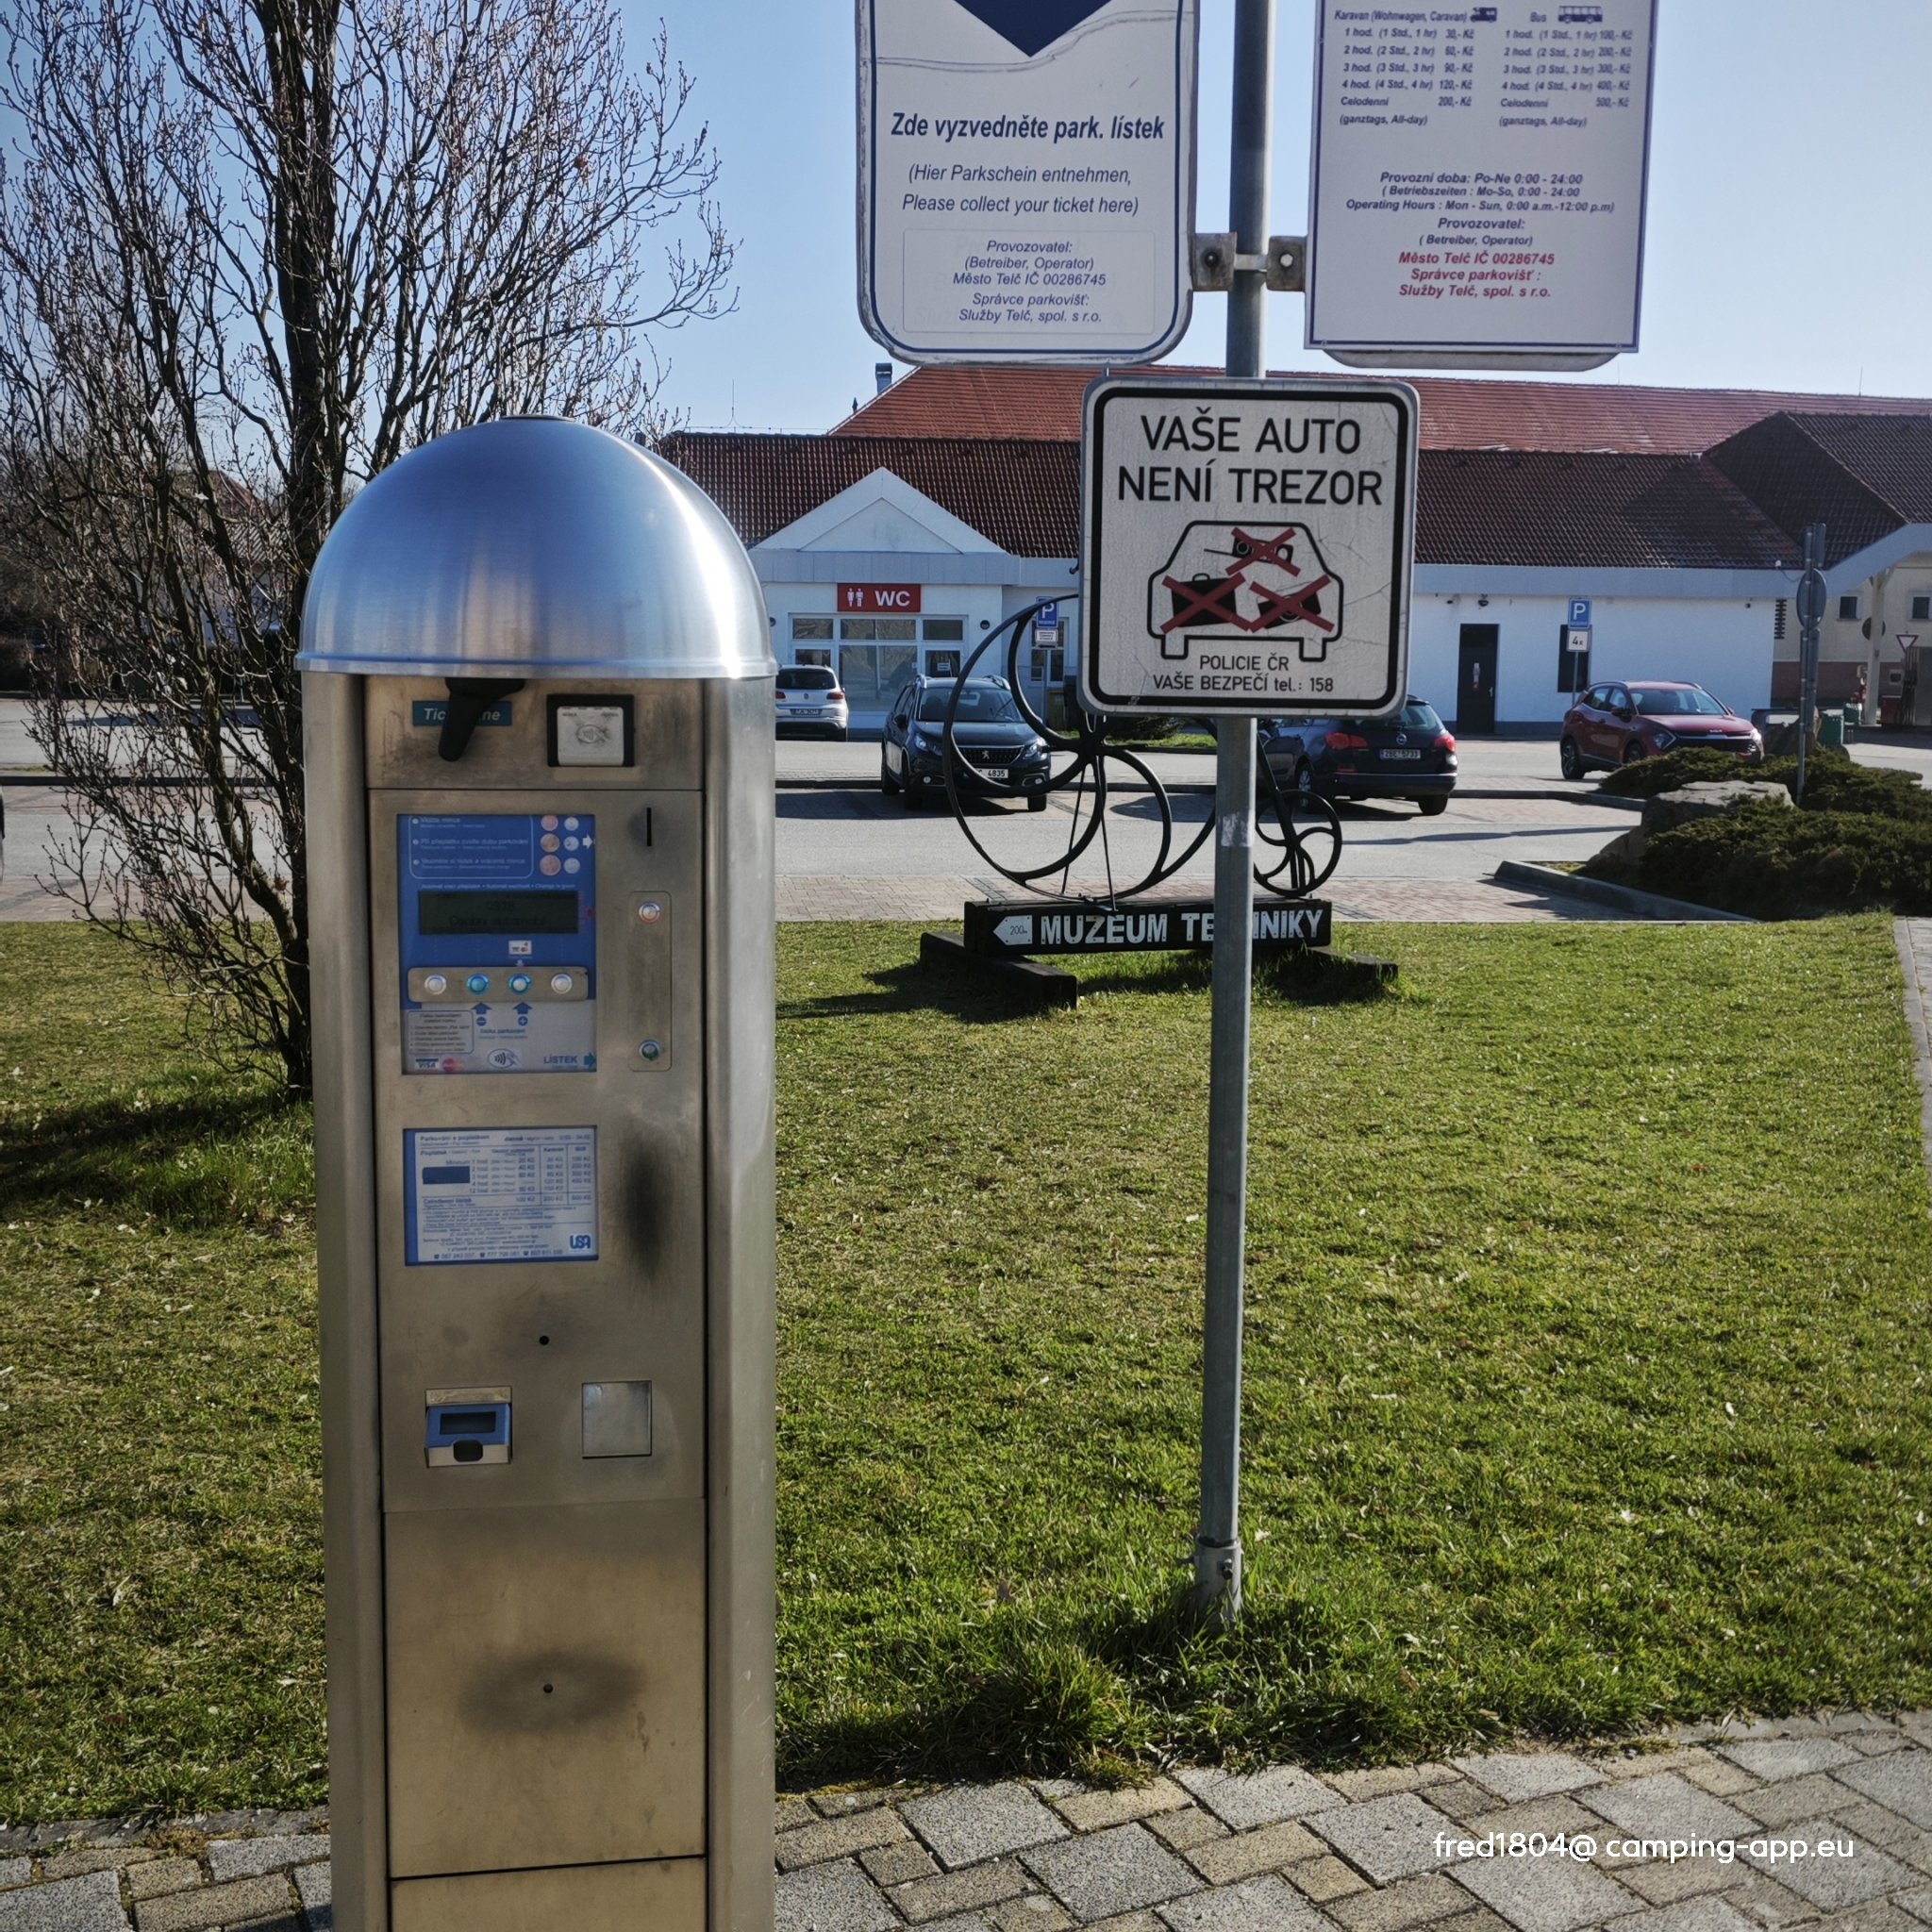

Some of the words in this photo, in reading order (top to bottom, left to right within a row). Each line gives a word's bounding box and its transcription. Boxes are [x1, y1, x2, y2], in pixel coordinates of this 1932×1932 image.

[1334, 9, 1369, 21] Karavan
[1429, 11, 1469, 23] Caravan)
[1530, 11, 1547, 23] Bus
[1345, 27, 1350, 37] 1
[1353, 27, 1373, 37] hod.
[1379, 27, 1389, 40] (1
[1391, 28, 1412, 38] Std.,
[1423, 28, 1438, 40] hr)
[1343, 45, 1350, 55] 2
[1352, 45, 1373, 55] hod.
[1376, 45, 1387, 57] (2
[1389, 45, 1410, 56] Std.,
[1413, 46, 1420, 56] 2
[1422, 46, 1435, 58] hr)
[1343, 62, 1350, 72] 3
[1351, 62, 1373, 73] hod.
[1376, 63, 1387, 75] (3
[1389, 63, 1409, 74] Std.,
[1412, 63, 1419, 73] 3
[1421, 63, 1435, 75] hr)
[1341, 80, 1348, 89] 4
[1350, 79, 1372, 89] hod.
[1374, 80, 1385, 92] (4
[1387, 80, 1408, 91] Std.,
[1411, 80, 1417, 90] 4
[1419, 80, 1433, 92] hr)
[891, 112, 928, 136] Zde
[935, 114, 1048, 142] vyzvedněte
[1054, 115, 1104, 143] park.
[1110, 115, 1164, 139] lístek
[1391, 114, 1427, 126] All-day)
[908, 163, 947, 183] (Hier
[951, 164, 1037, 182] Parkschein
[1042, 167, 1131, 186] entnehmen,
[1380, 173, 1434, 184] Provozní
[1437, 173, 1471, 184] doba:
[1474, 173, 1510, 184] Po-Ne
[1514, 174, 1540, 184] 0:00
[1550, 174, 1583, 184] 24:00
[1389, 186, 1467, 196] Betriebszeiten
[1476, 186, 1515, 198] Mo-So,
[1518, 187, 1540, 197] 0:00
[1550, 187, 1580, 197] 24:00
[902, 193, 955, 211] Please
[960, 195, 1009, 212] collect
[1014, 199, 1049, 216] your
[1053, 196, 1094, 212] ticket
[1098, 196, 1139, 216] here)
[1346, 199, 1400, 211] Operating
[1403, 200, 1435, 210] Hours
[1445, 200, 1469, 210] Mon
[1479, 201, 1504, 212] Sun,
[1507, 201, 1530, 210] 0:00
[1438, 218, 1525, 230] Provozovatel:
[987, 240, 1073, 253] Provozovatel:
[1426, 235, 1478, 246] Betreiber,
[1481, 235, 1533, 247] Operator)
[964, 256, 1029, 271] (Betreiber,
[1034, 257, 1094, 272] Operator)
[1398, 252, 1439, 264] Město
[1443, 252, 1470, 264] Telč
[1474, 250, 1488, 264] IČ
[1492, 253, 1555, 265] 00286745
[953, 272, 991, 285] Město
[996, 273, 1022, 285] Telč
[1024, 271, 1040, 286] IČ
[1042, 274, 1107, 287] 00286745
[1410, 269, 1465, 281] Správce
[1399, 285, 1443, 299] Služby
[1448, 285, 1478, 298] Telč,
[1483, 286, 1514, 299] spol.
[1520, 289, 1526, 297] s
[1530, 288, 1551, 297] r.o.
[972, 292, 1024, 308] Správce
[958, 308, 1002, 324] Služby
[1006, 309, 1033, 322] Telč,
[1038, 310, 1067, 324] spol.
[1072, 313, 1079, 322] s
[1082, 312, 1102, 323] r.o.
[1141, 407, 1241, 453] VAŠE
[1255, 418, 1360, 454] AUTO
[1118, 458, 1216, 502] NENÍ
[1228, 467, 1382, 506] TREZOR
[874, 591, 910, 607] WC
[1041, 602, 1055, 619] P
[1573, 602, 1586, 620] P
[1199, 656, 1261, 671] POLICIE
[1267, 653, 1290, 672] ČR
[1153, 672, 1194, 691] VAŠE
[1200, 673, 1269, 691] BEZPEČÍ
[1309, 677, 1334, 692] 158
[1041, 913, 1167, 944] MUZEUM
[1181, 909, 1324, 941] TENIKY
